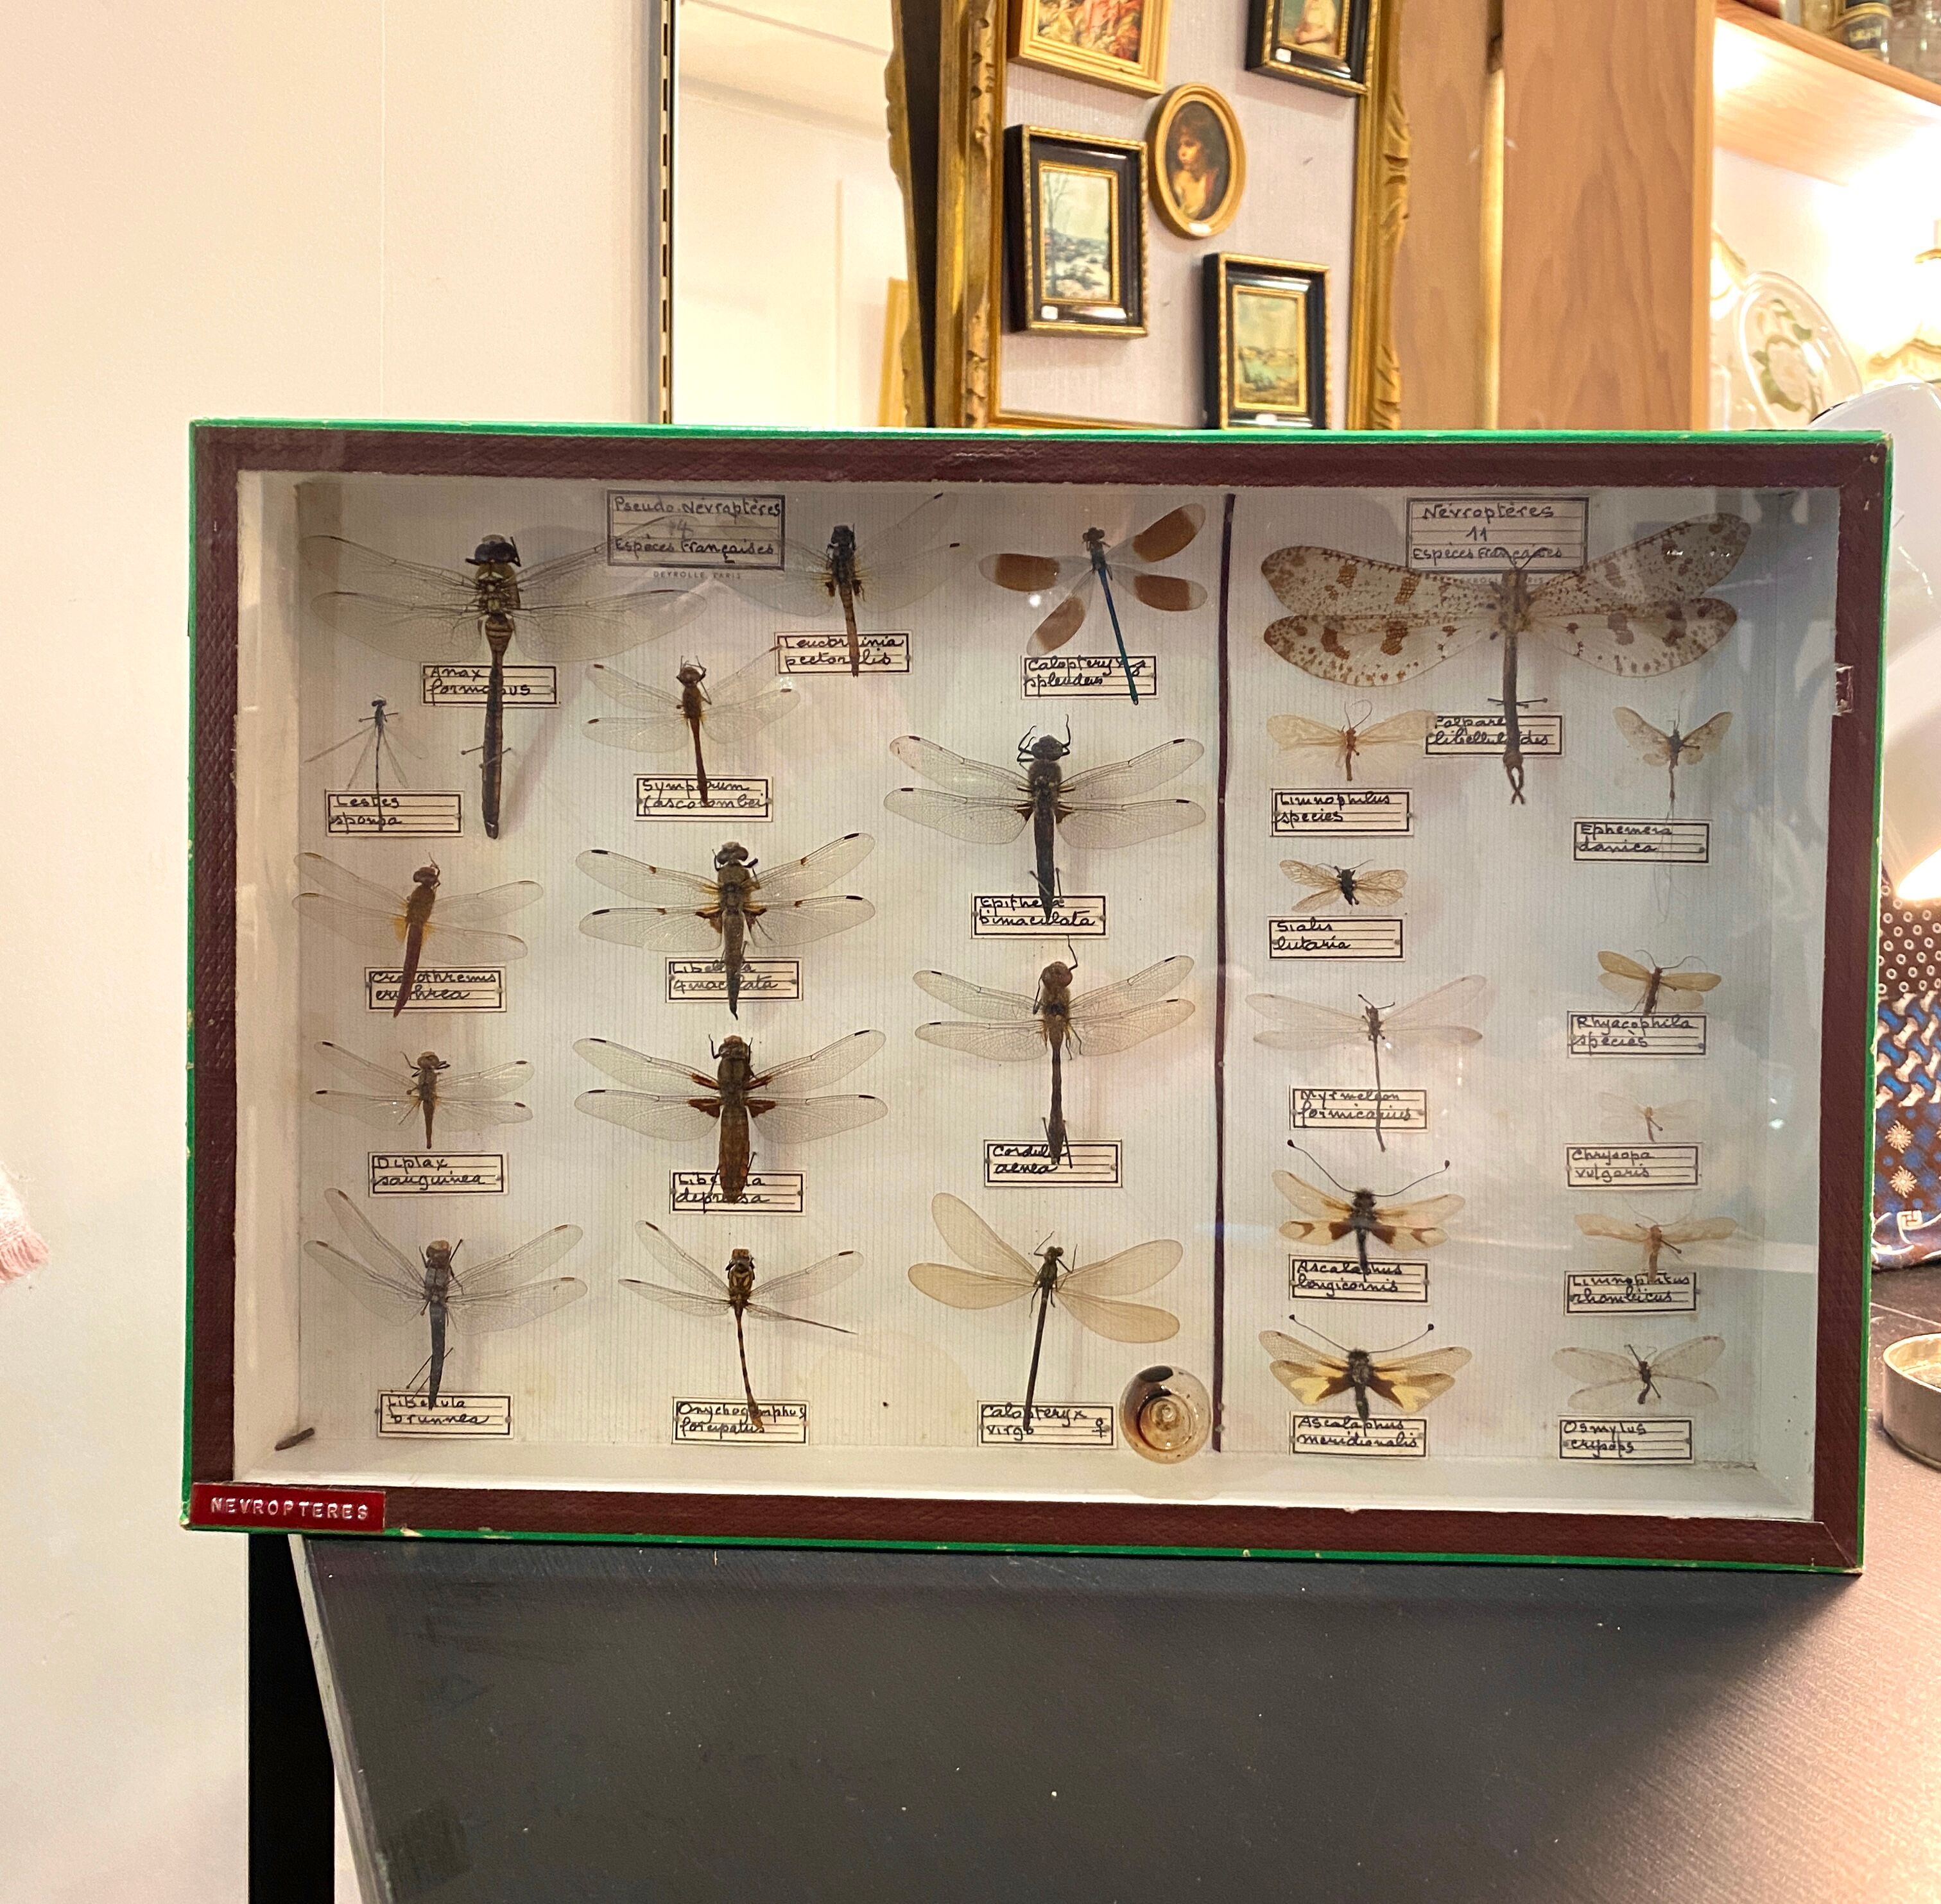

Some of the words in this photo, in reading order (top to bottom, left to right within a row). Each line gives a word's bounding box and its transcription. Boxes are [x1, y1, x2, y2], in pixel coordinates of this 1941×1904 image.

[653, 570, 705, 579] DEYROLLE
[430, 666, 483, 681] Anax
[211, 1497, 369, 1520] NEVROPTERES
